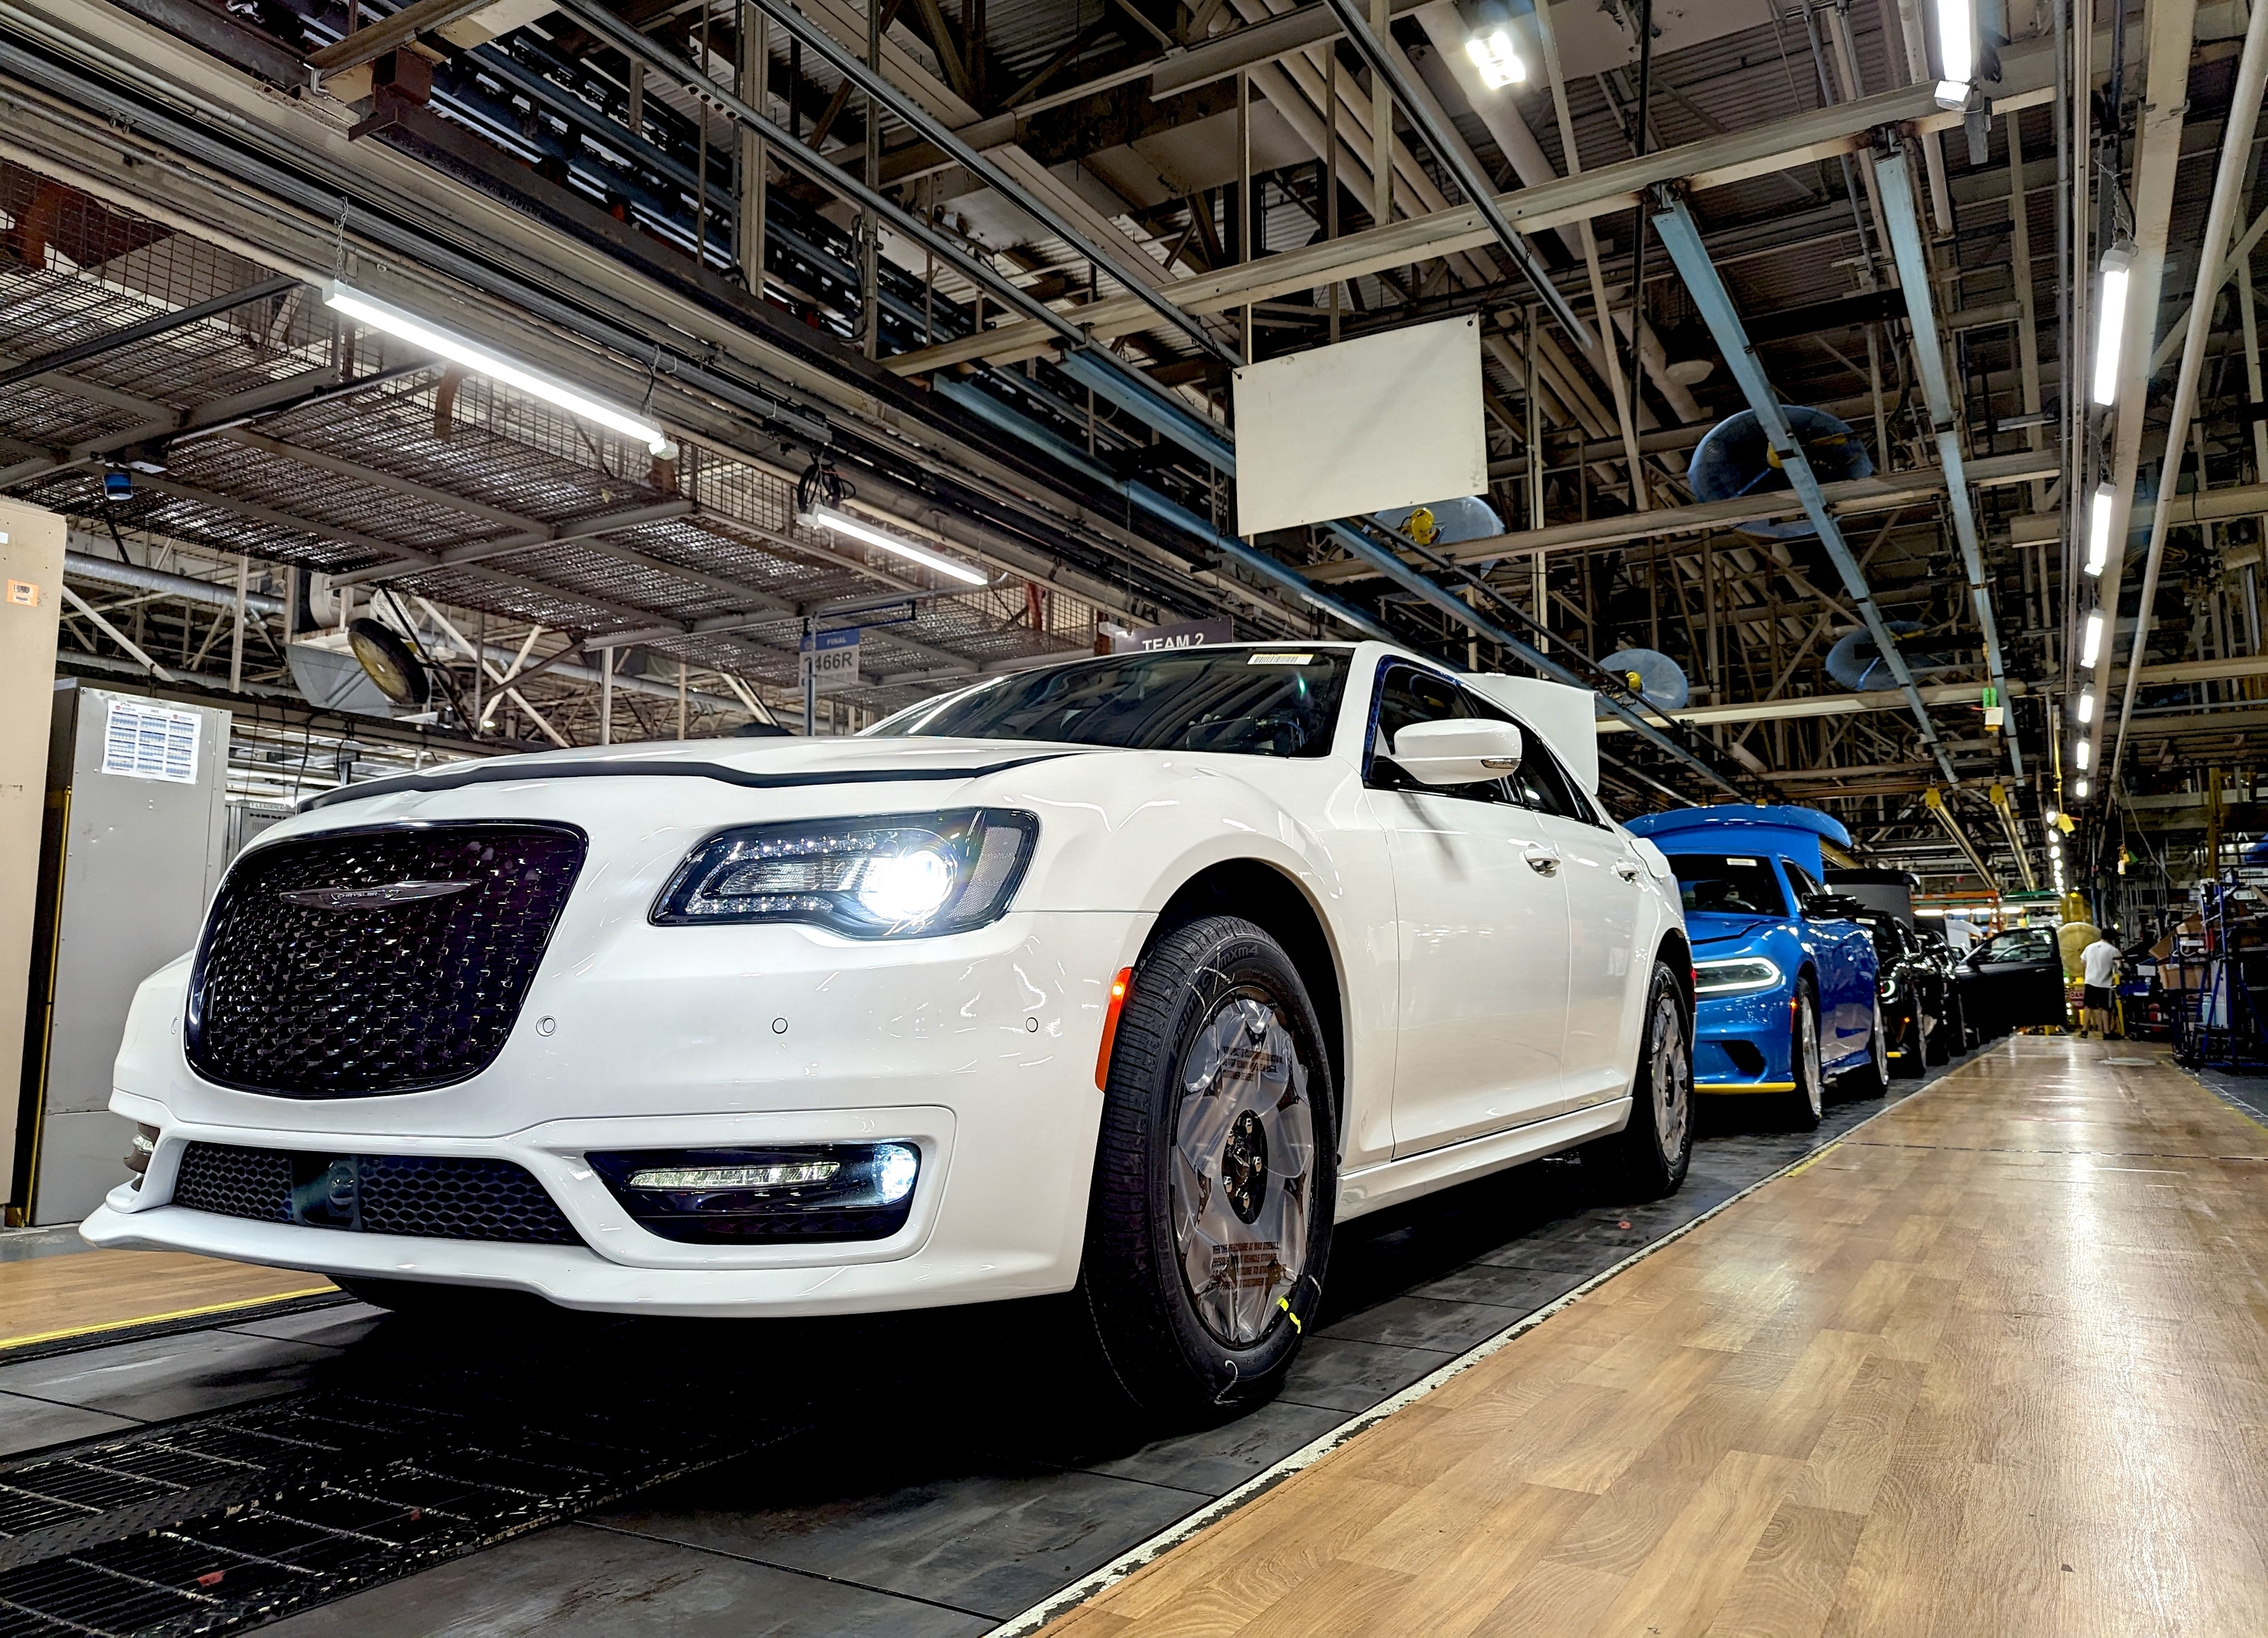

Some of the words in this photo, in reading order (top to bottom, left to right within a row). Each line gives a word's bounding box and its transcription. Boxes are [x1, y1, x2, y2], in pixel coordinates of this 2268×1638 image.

[826, 636, 847, 646] FINAL
[1142, 634, 1189, 651] TEAM
[1194, 633, 1204, 646] 2
